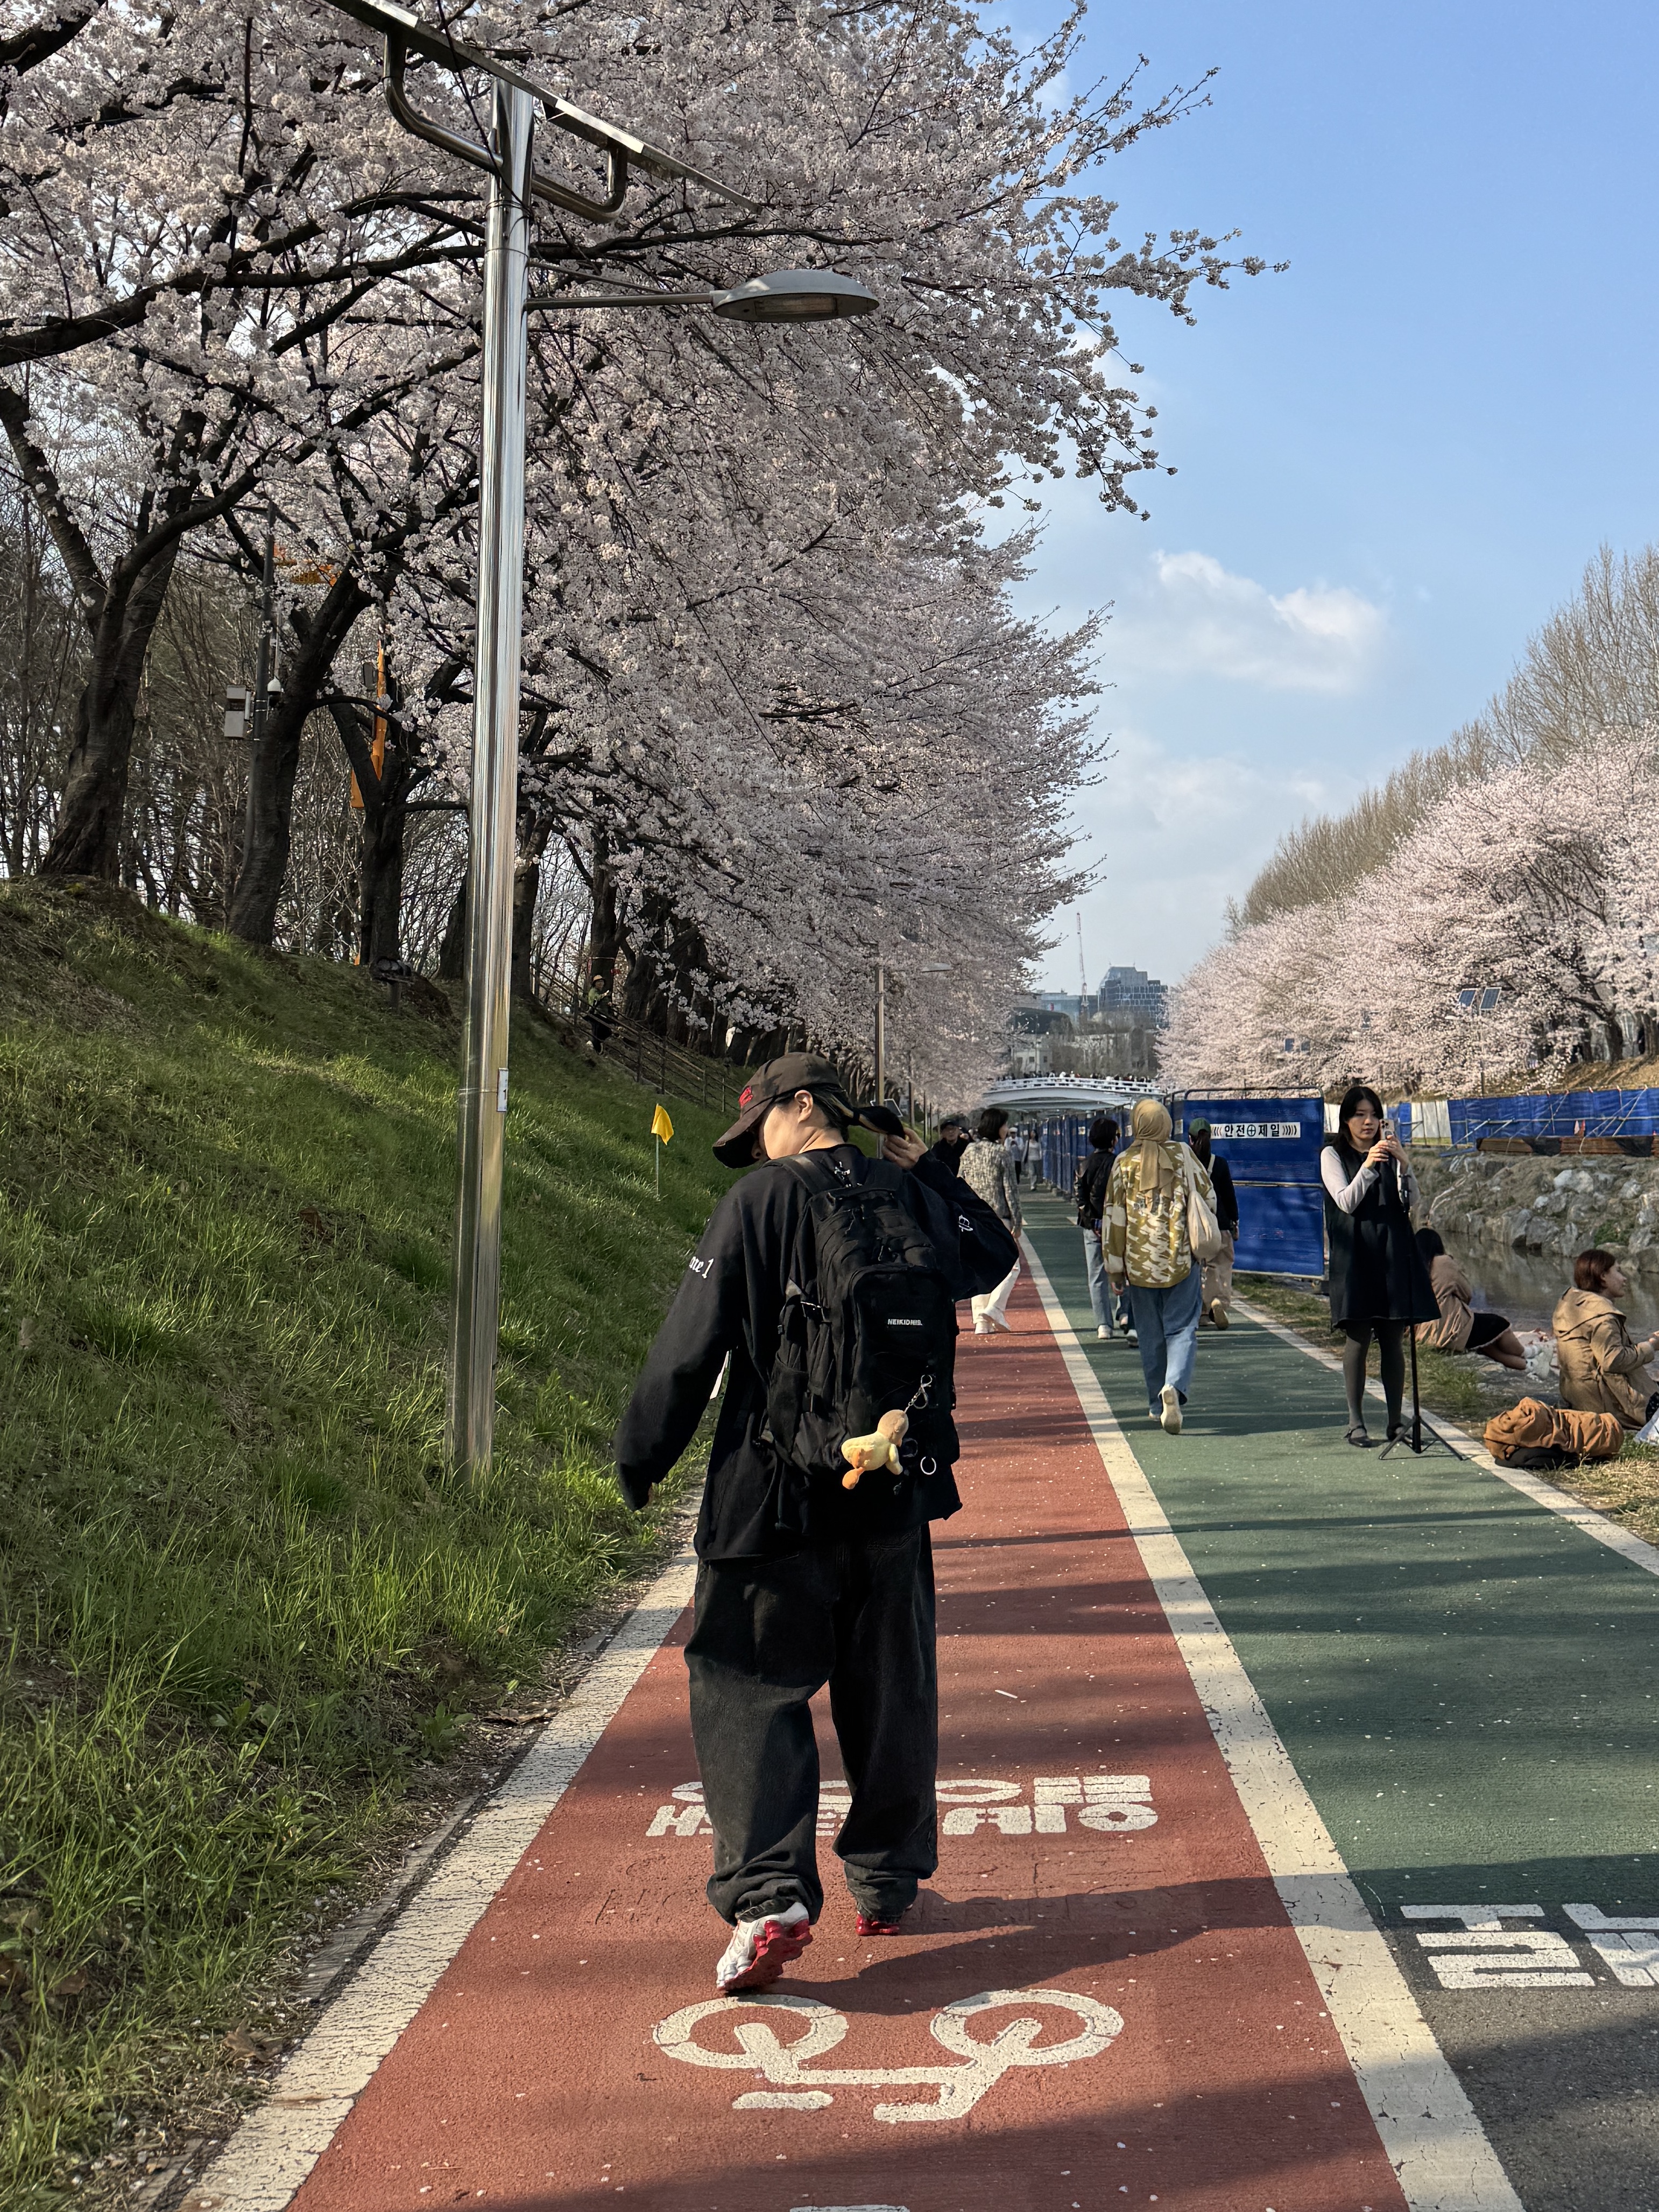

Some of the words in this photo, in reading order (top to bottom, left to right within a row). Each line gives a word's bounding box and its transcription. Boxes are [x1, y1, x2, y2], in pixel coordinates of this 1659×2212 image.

[1224, 1124, 1246, 1137] 안전
[1258, 1123, 1280, 1137] 제일
[646, 1775, 1159, 1838] 일방
